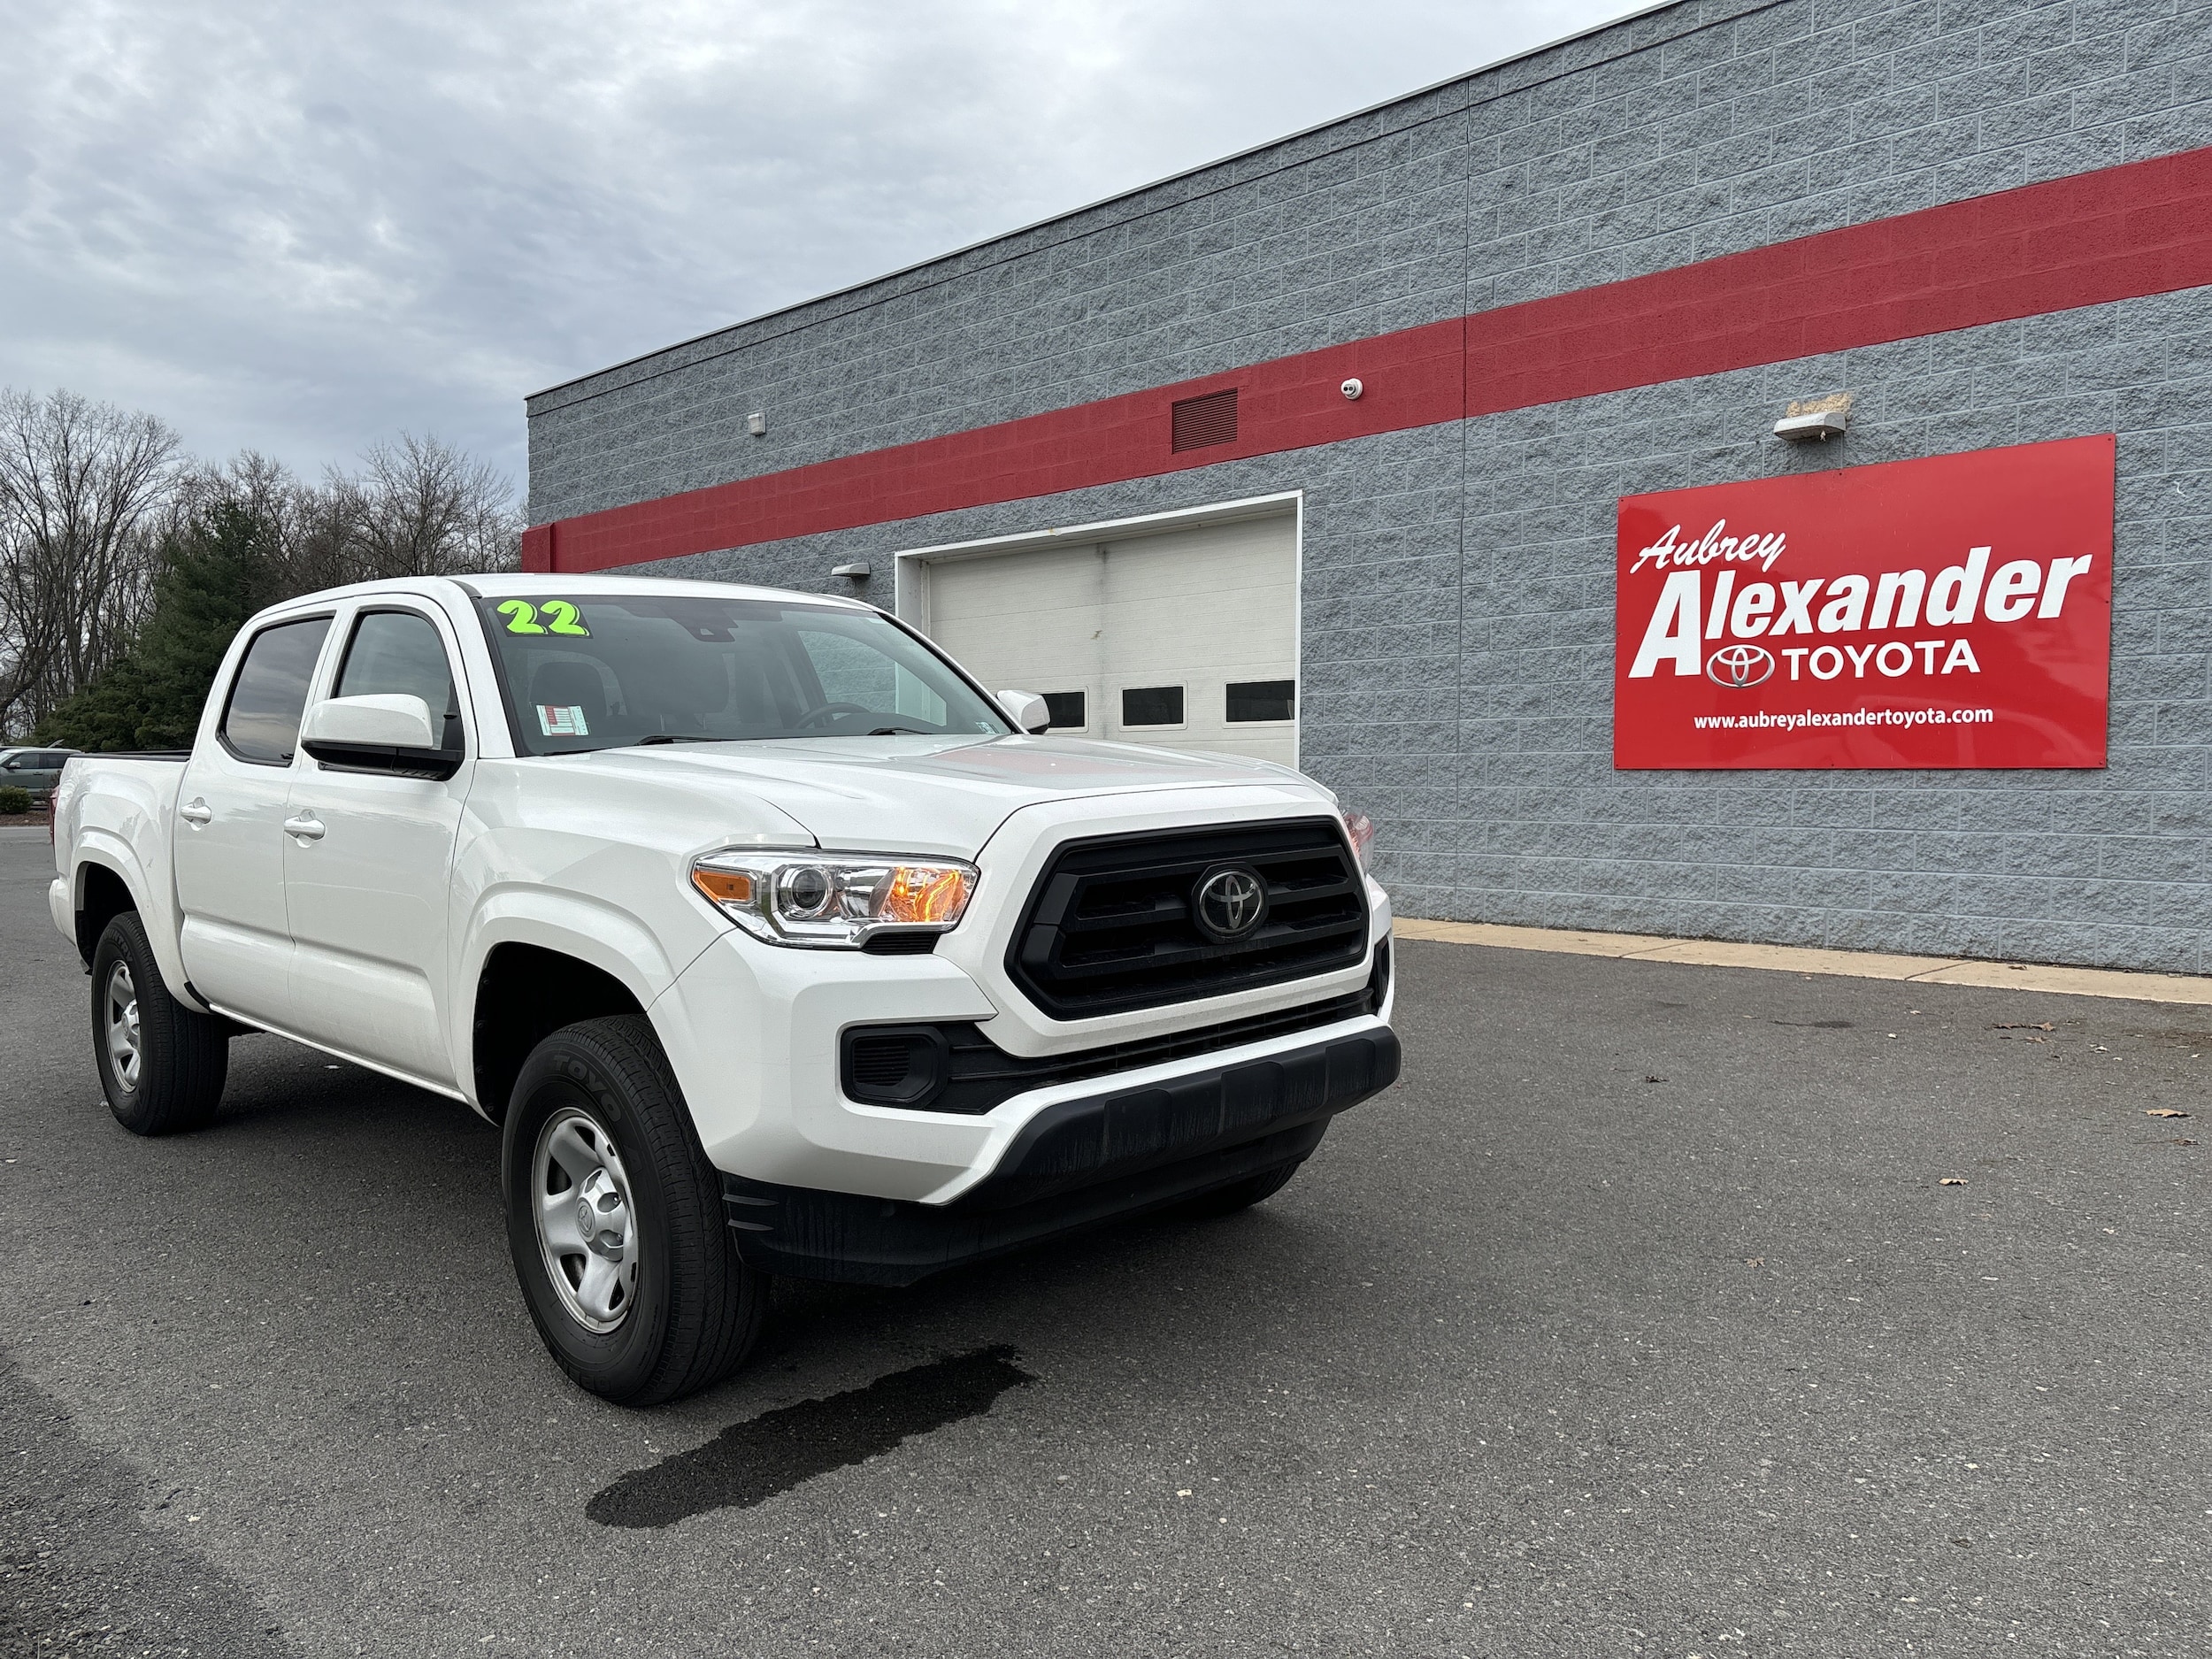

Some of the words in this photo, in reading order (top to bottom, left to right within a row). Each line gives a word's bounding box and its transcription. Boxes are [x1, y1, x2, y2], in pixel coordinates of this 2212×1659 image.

[1630, 518, 1787, 574] Aubrey
[496, 599, 590, 636] 22
[1628, 545, 2093, 679] Alexander
[1781, 638, 1981, 680] TOYOTA
[1694, 706, 1993, 732] www.aubreyalexandertoyota.com
[553, 1054, 623, 1123] TOYO
